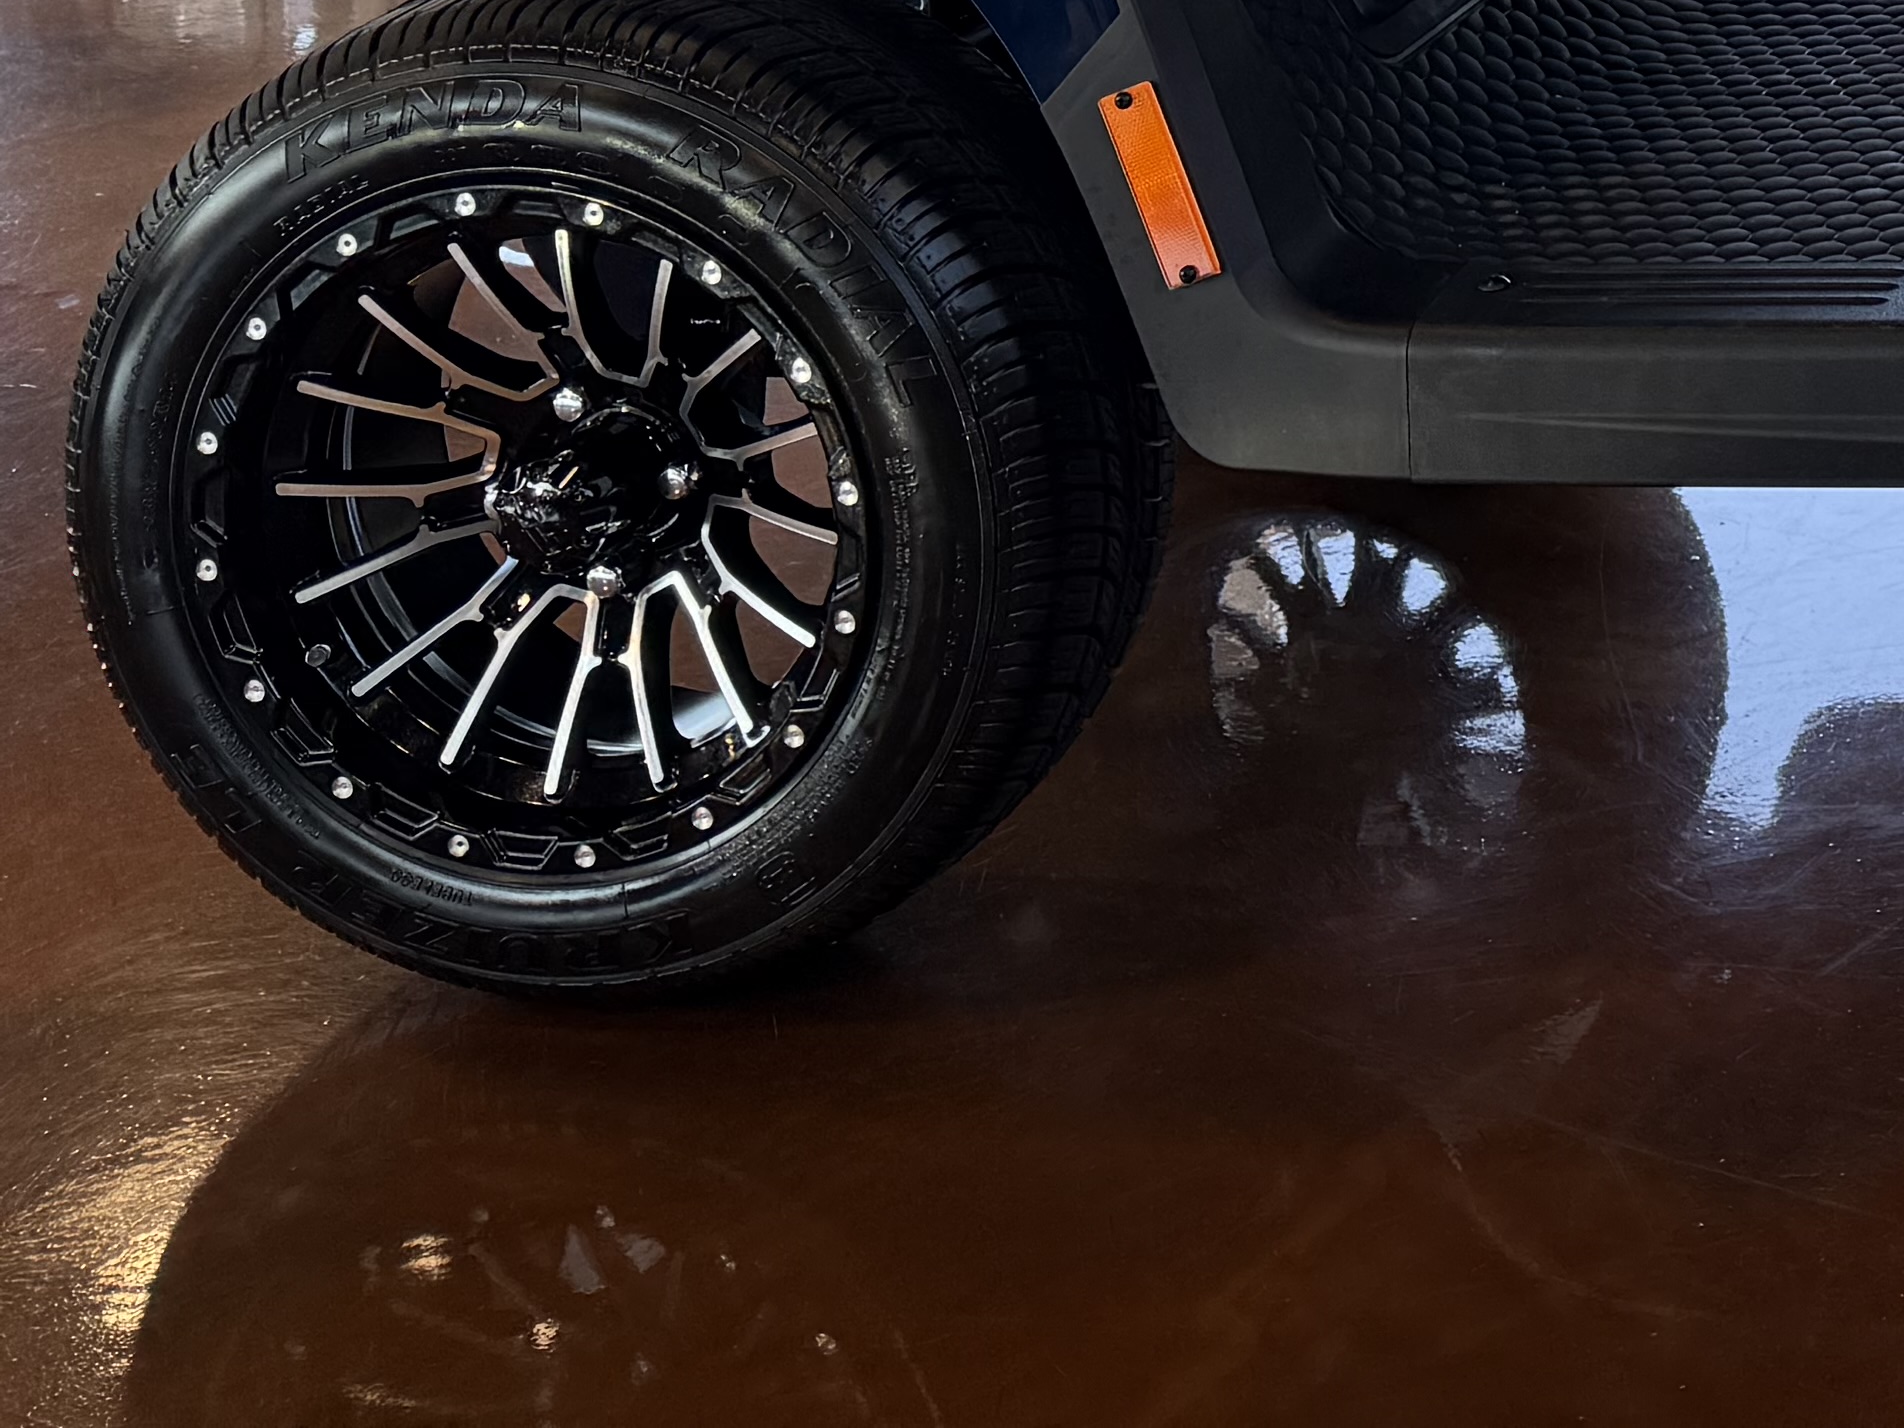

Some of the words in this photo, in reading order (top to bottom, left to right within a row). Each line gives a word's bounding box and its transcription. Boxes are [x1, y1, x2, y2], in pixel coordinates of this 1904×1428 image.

[284, 78, 583, 185] KENDA
[668, 128, 940, 406] RADIAL
[289, 851, 698, 971] KRUIZER
